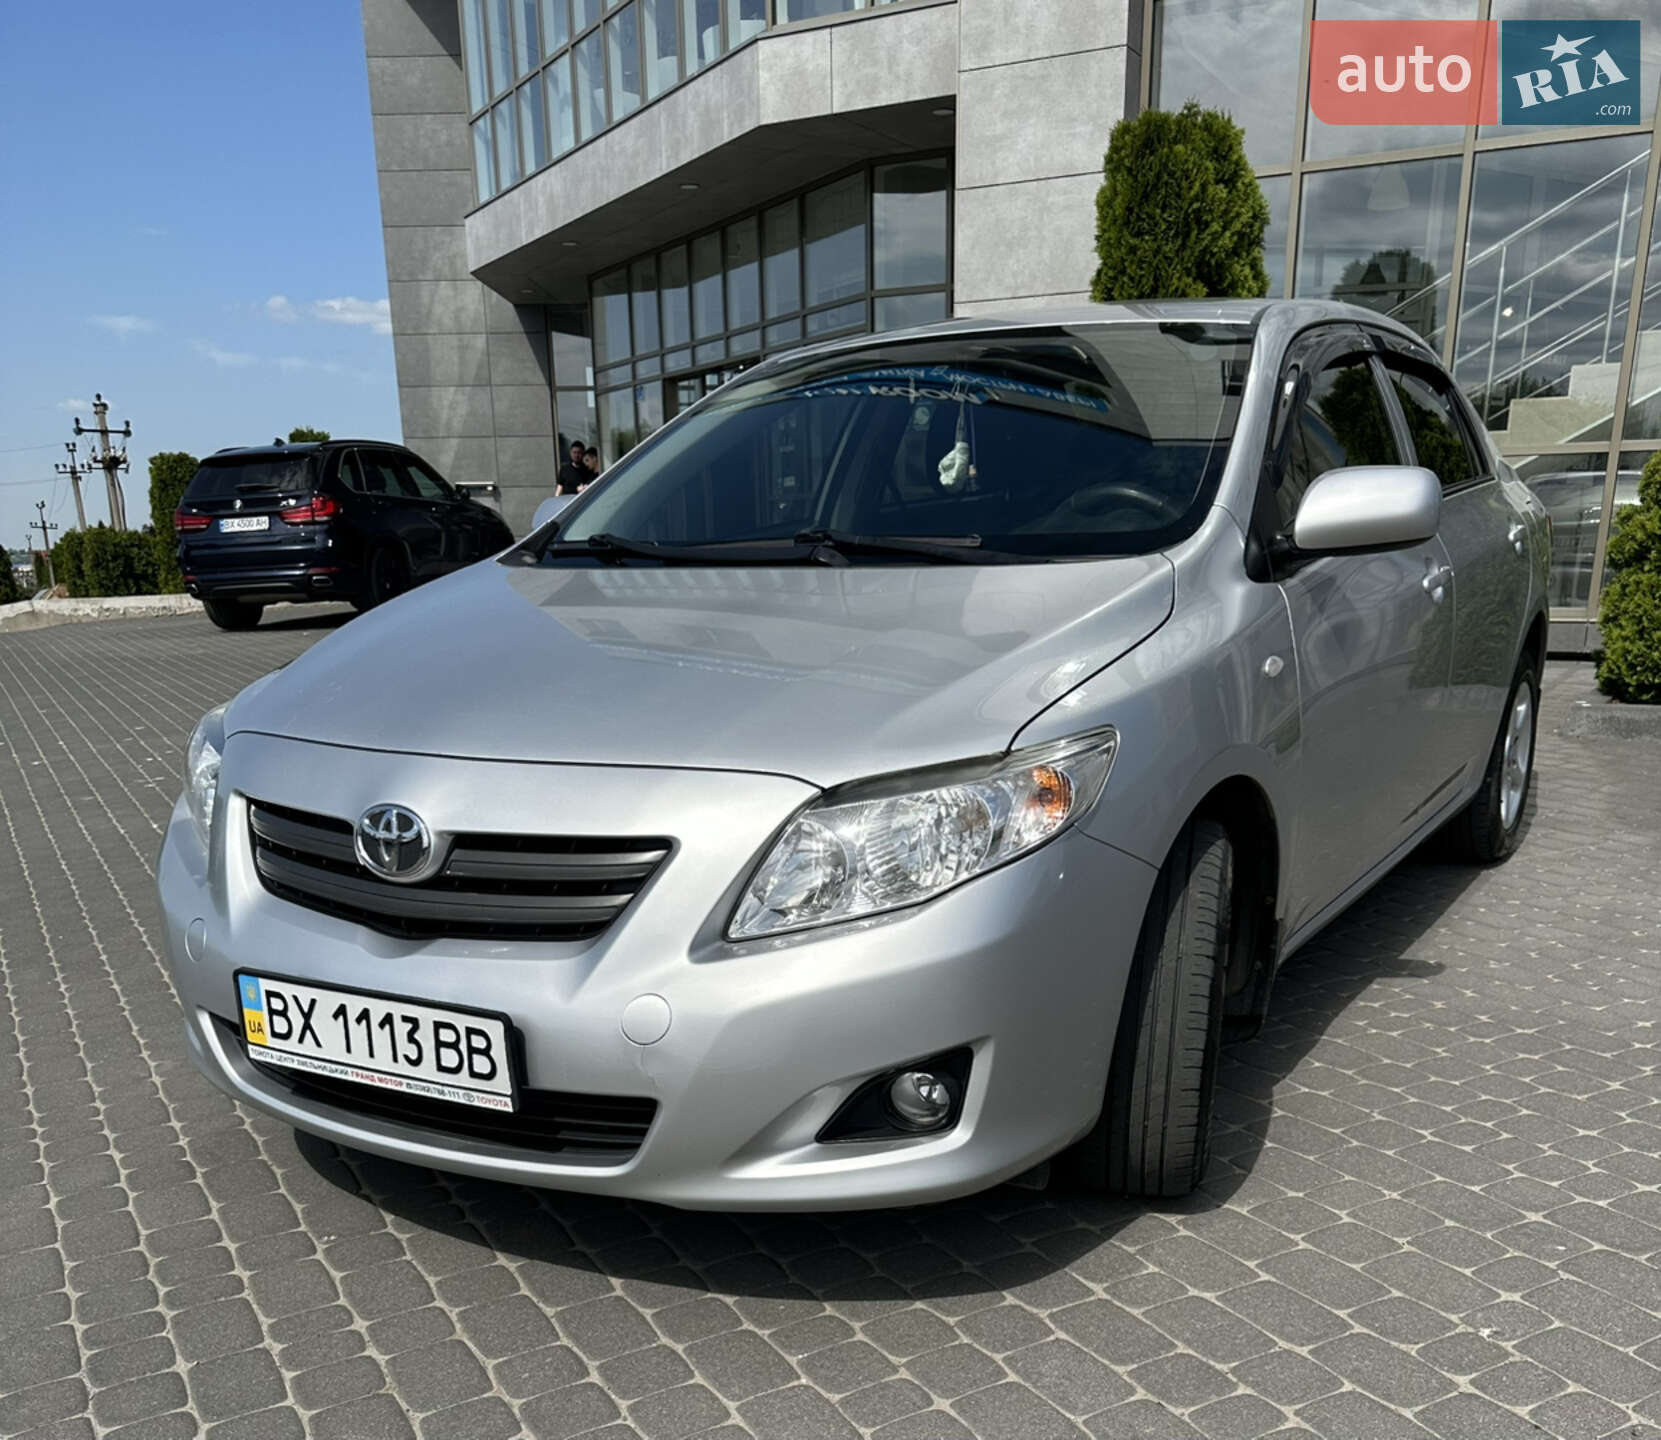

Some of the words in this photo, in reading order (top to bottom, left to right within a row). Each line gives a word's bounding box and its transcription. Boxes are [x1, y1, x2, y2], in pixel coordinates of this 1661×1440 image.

[249, 1021, 264, 1035] UA
[265, 989, 323, 1048] BX
[331, 1003, 424, 1067] 1113
[433, 1020, 497, 1081] BB
[477, 1095, 509, 1108] TOYOTA
